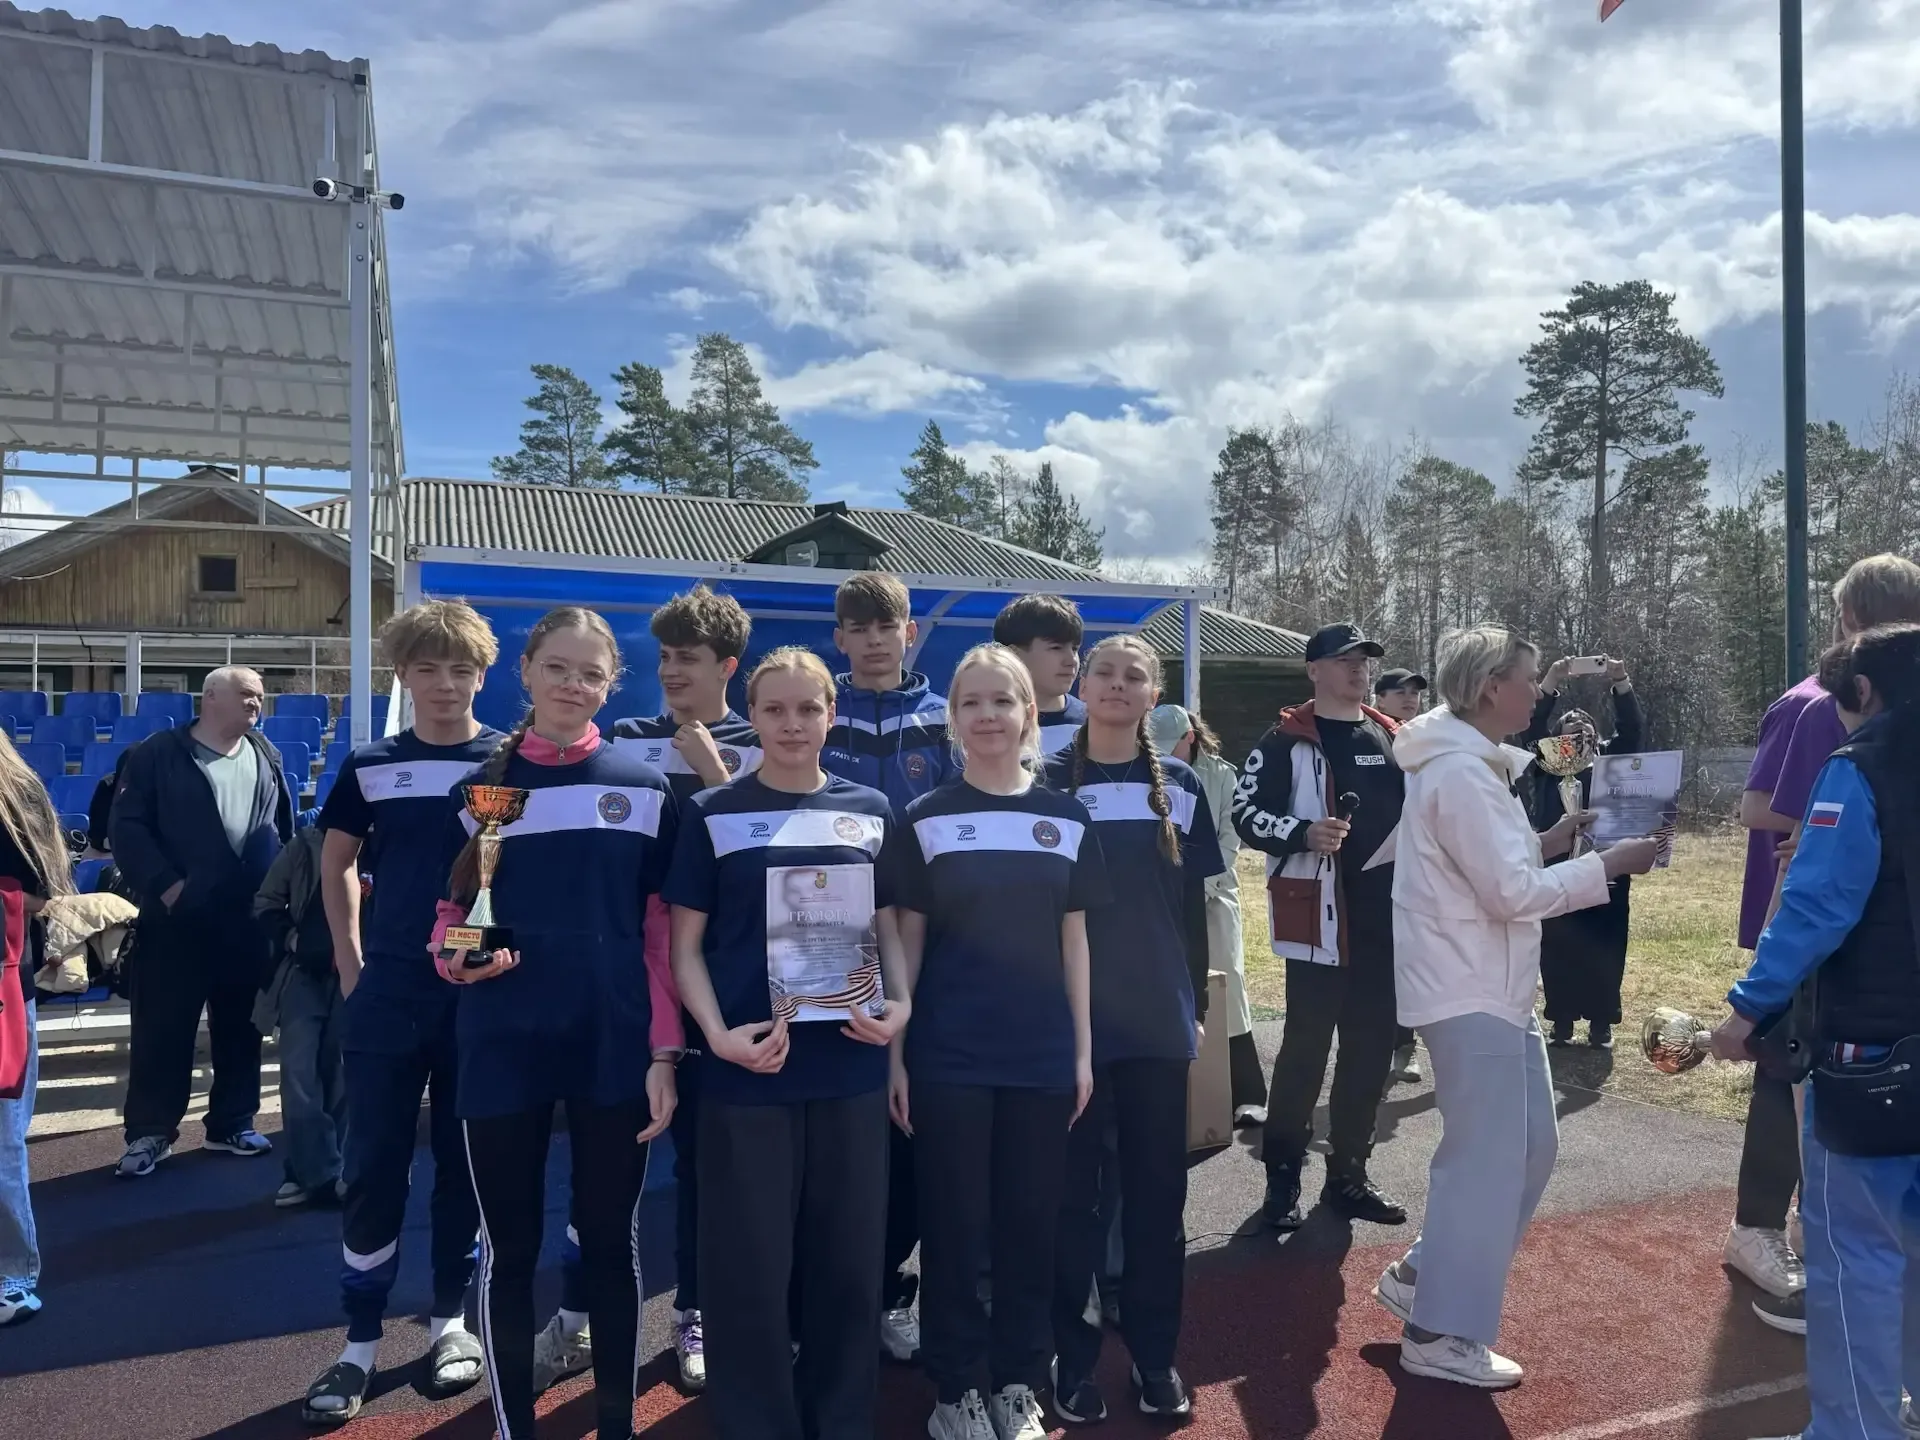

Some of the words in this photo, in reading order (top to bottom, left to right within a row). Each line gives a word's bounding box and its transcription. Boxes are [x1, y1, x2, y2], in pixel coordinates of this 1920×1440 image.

[834, 751, 860, 764] PATRCK
[1356, 756, 1384, 764] CRUSH
[789, 909, 851, 921] ГРАМОТА
